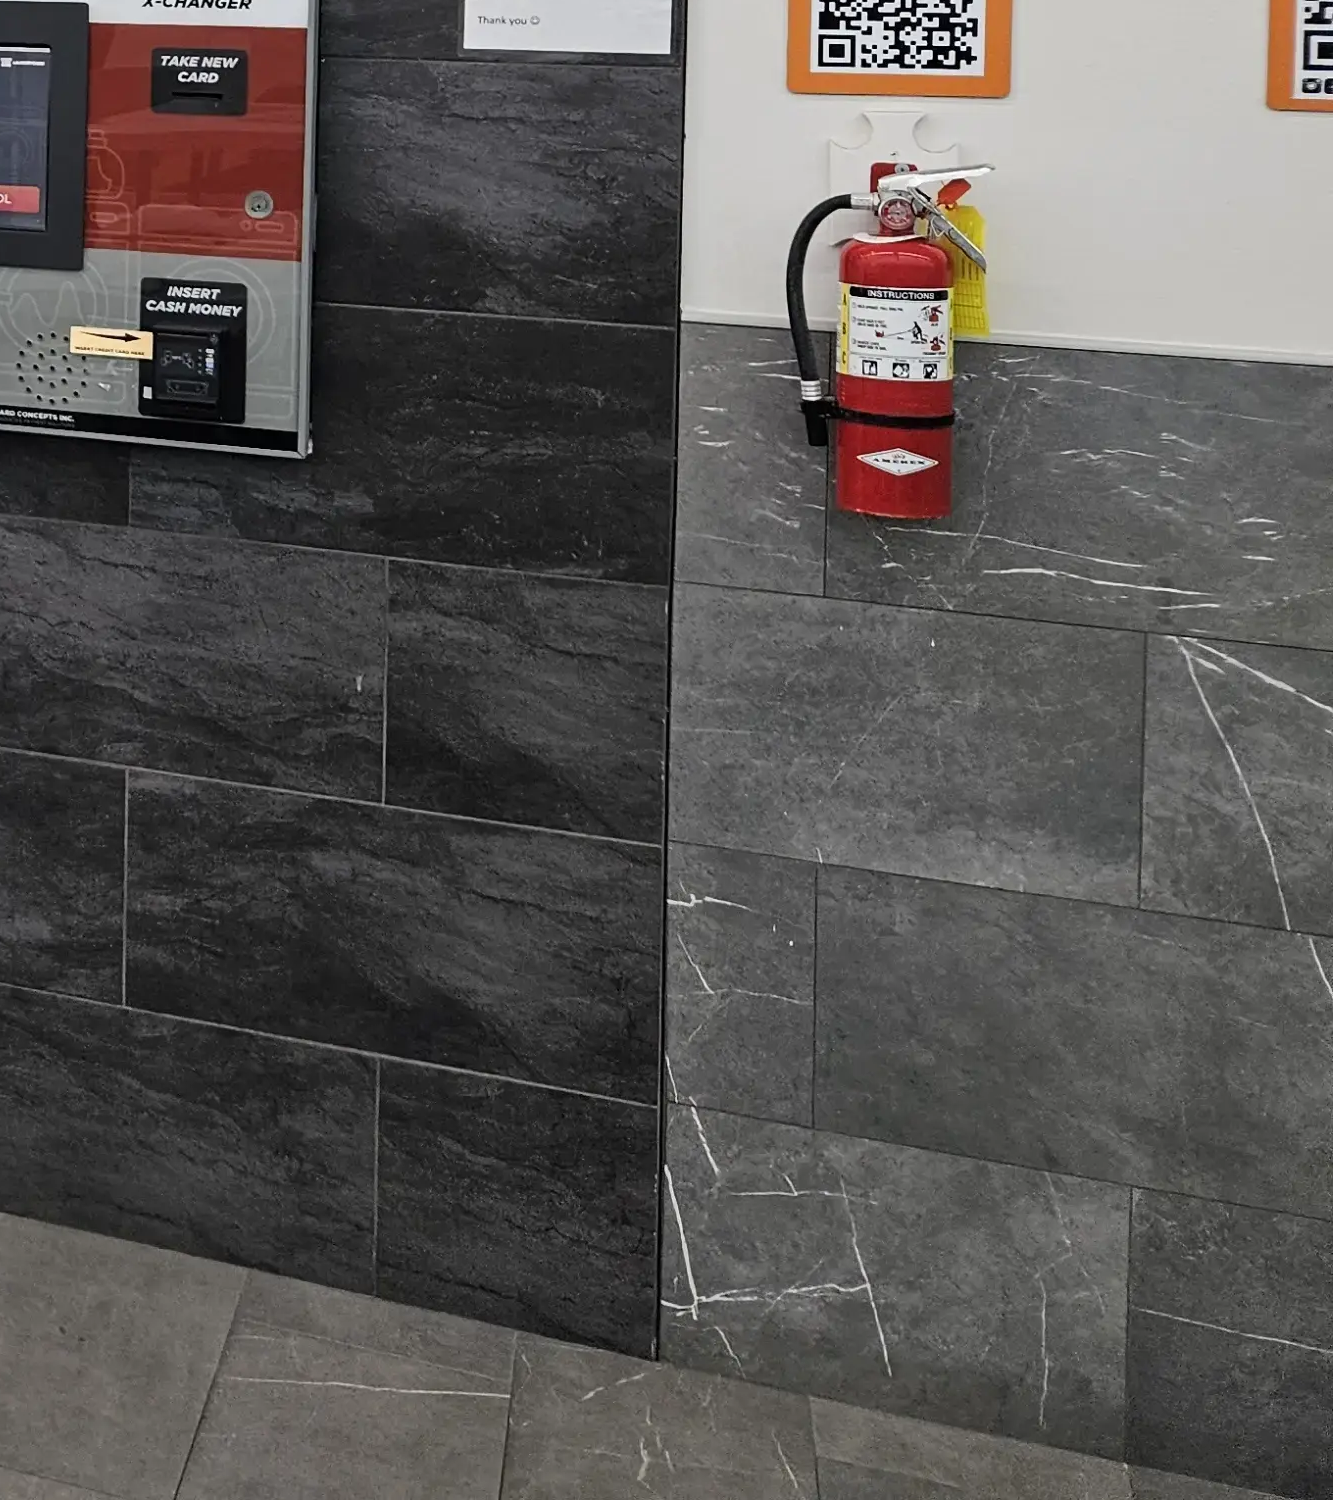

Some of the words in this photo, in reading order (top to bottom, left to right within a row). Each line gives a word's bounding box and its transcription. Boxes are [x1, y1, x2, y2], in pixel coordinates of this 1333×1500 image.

[478, 16, 506, 24] Thank
[509, 17, 527, 26] you
[160, 55, 199, 67] TAKE
[202, 57, 239, 68] NEW
[178, 71, 219, 83] CARD
[167, 286, 221, 300] INSERT
[868, 290, 934, 299] INSTRUCTIONS
[146, 300, 185, 313] CASH
[188, 303, 243, 317] MONEY
[17, 411, 58, 420] CONCEPTS
